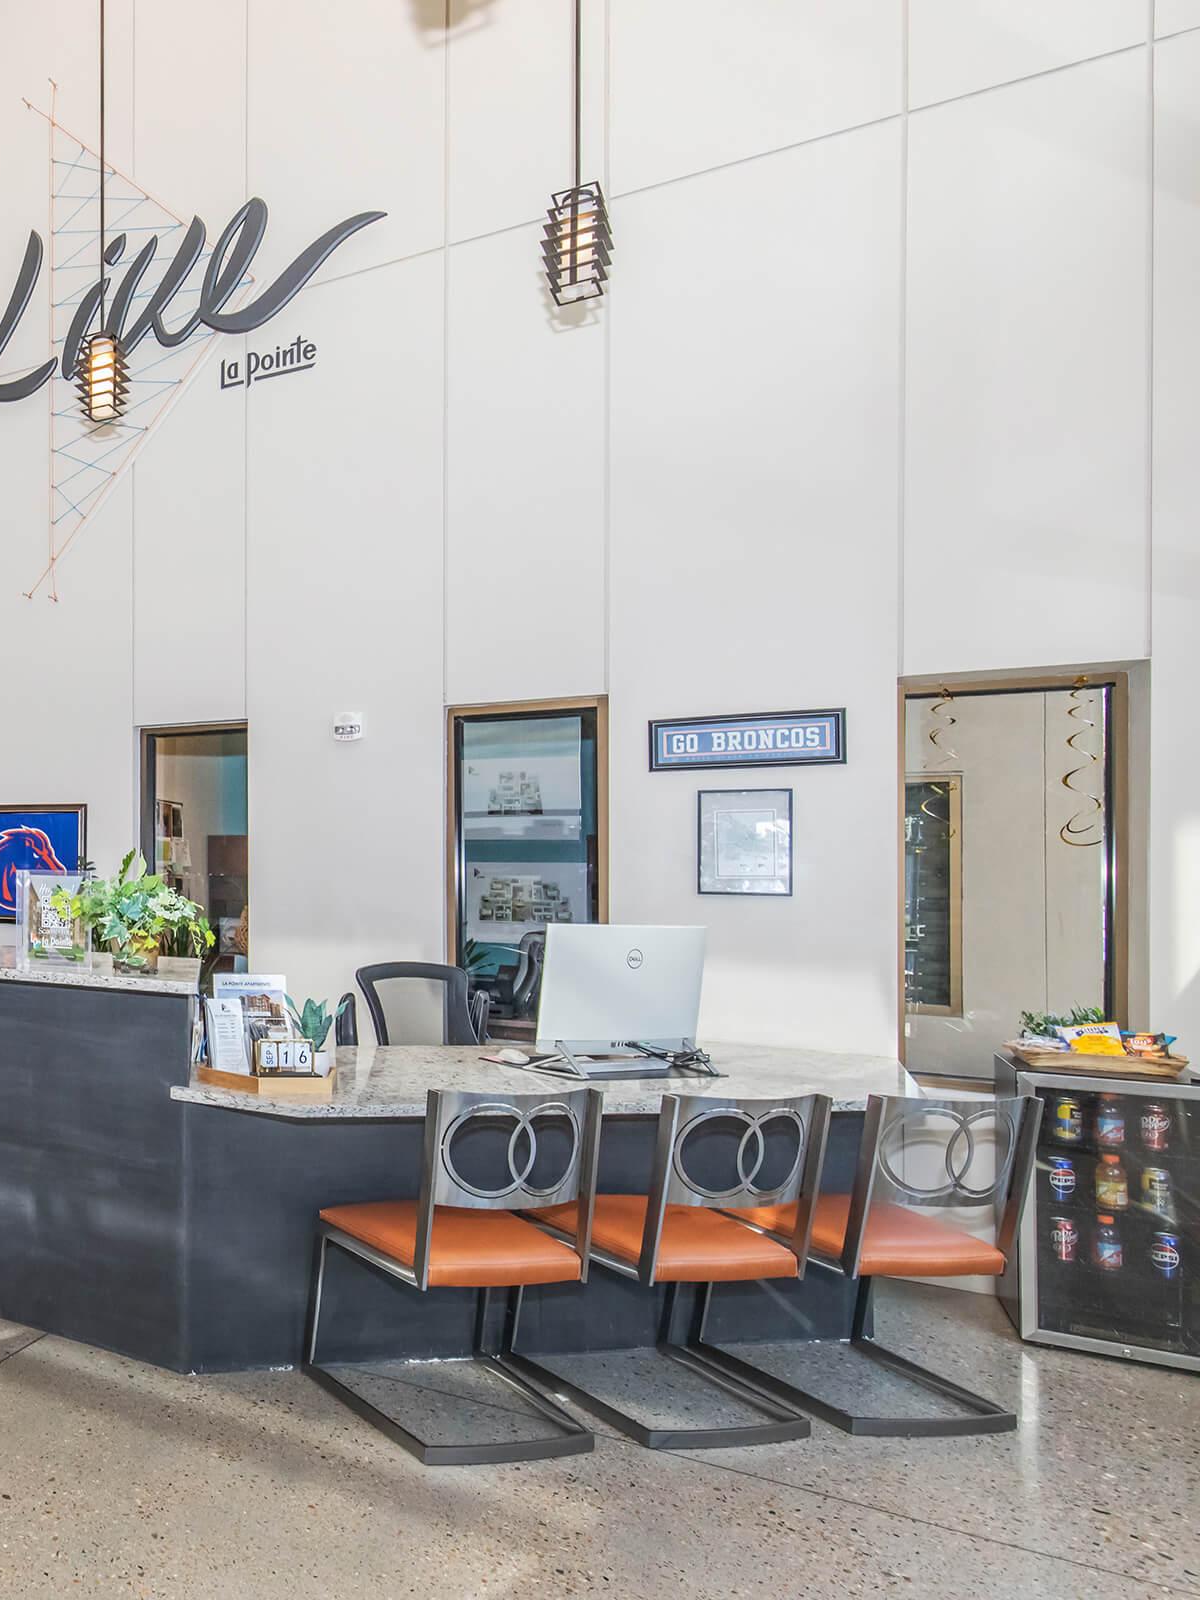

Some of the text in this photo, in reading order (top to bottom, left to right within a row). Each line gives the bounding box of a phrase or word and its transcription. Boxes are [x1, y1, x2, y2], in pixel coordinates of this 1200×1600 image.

[220, 359, 244, 389] La
[672, 727, 820, 753] GO BRONCOS
[265, 1050, 274, 1065] SEP
